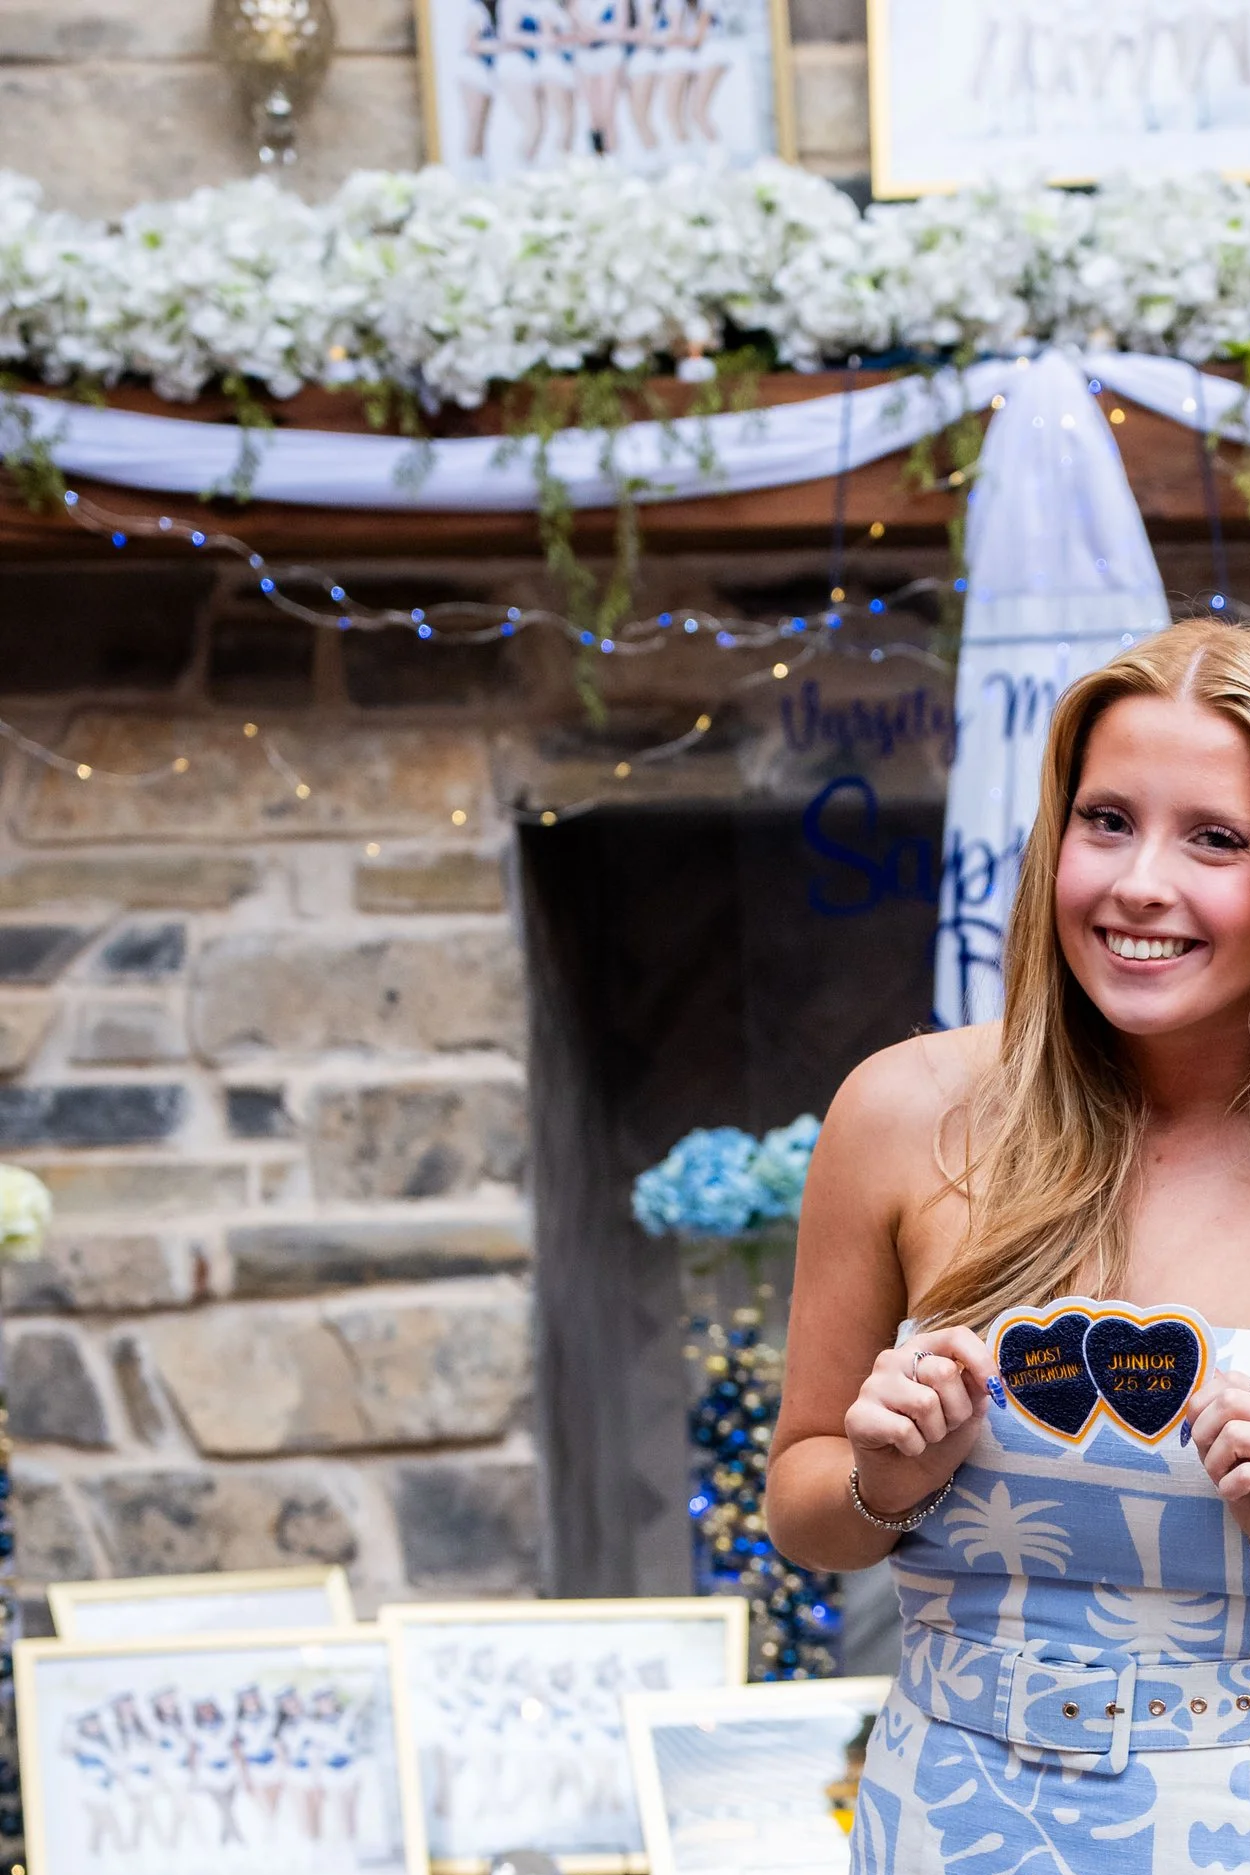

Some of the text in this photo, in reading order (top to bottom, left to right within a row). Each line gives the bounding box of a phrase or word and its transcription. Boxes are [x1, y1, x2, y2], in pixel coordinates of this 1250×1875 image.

[1025, 1346, 1062, 1367] MOST
[1107, 1353, 1177, 1371] JUNIOR
[1008, 1362, 1084, 1388] OUTSTANDING
[1113, 1375, 1172, 1392] 25 26
